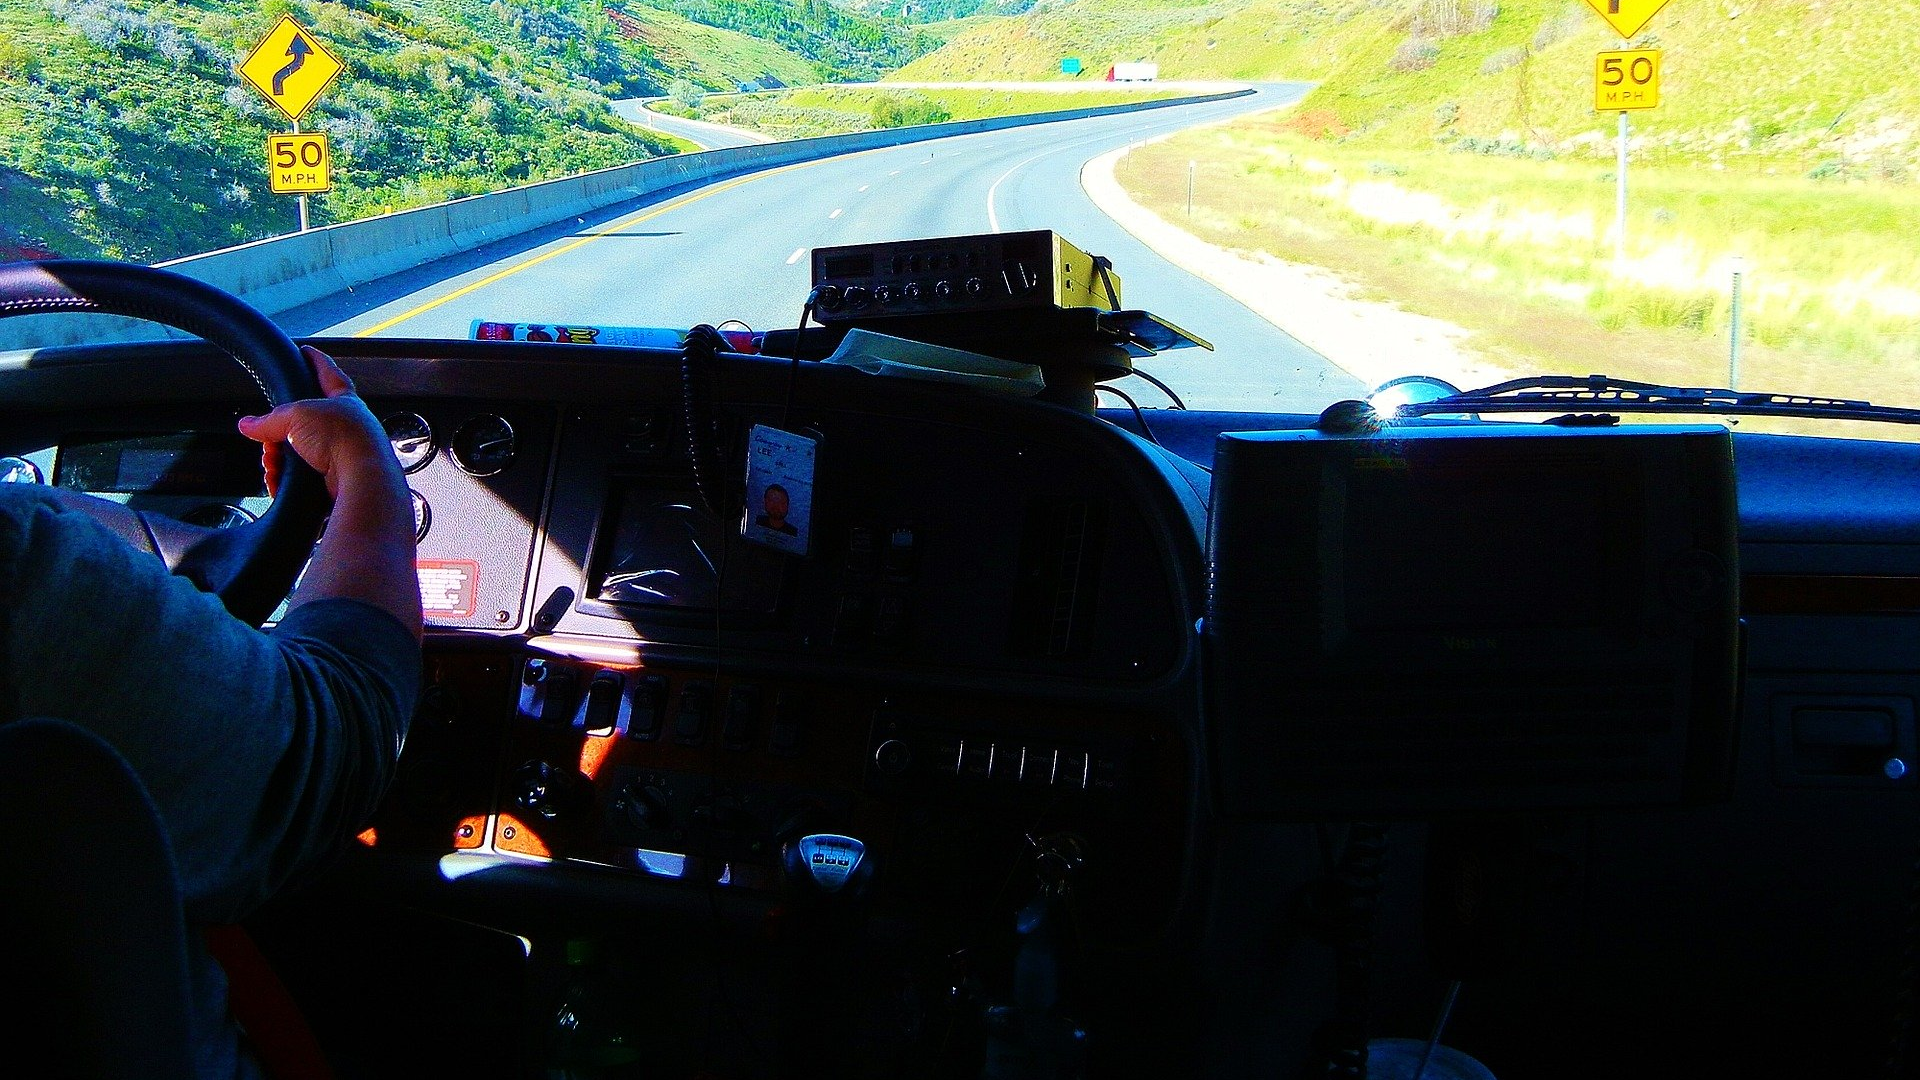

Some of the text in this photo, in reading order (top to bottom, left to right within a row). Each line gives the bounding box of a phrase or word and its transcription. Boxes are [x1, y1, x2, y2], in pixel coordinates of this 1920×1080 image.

[1602, 57, 1653, 86] 50
[275, 141, 322, 168] 50
[281, 173, 318, 184] M.P.H.
